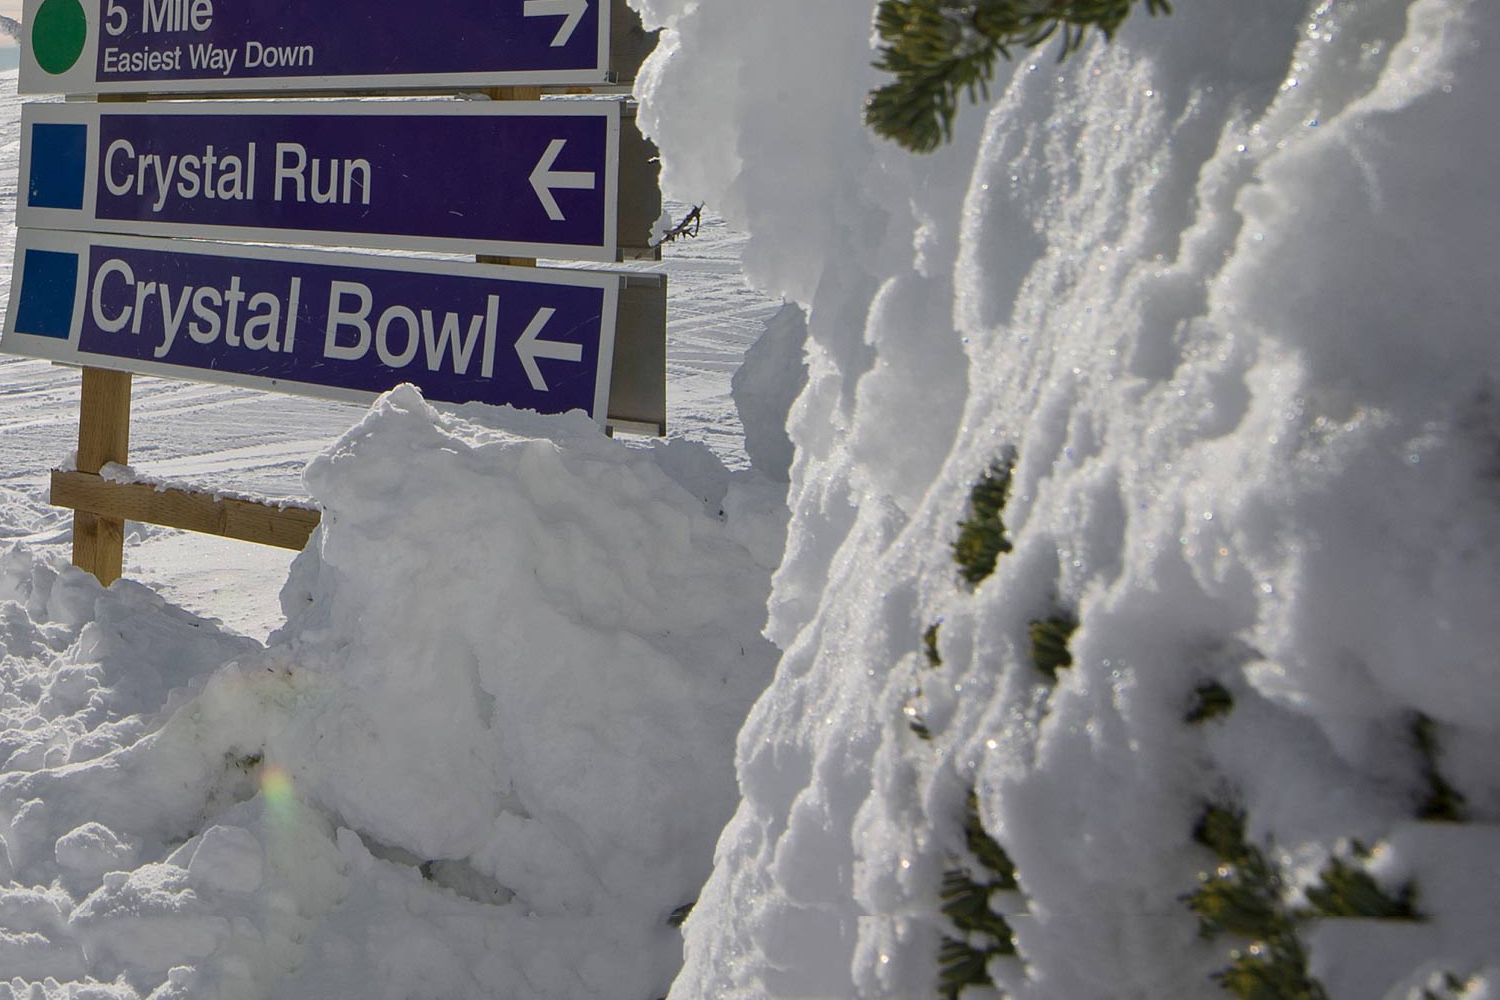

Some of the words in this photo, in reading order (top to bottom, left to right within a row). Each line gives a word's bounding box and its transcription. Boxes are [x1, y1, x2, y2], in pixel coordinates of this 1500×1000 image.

[103, 47, 182, 73] Easiest
[188, 44, 237, 76] Way
[244, 41, 314, 68] Down
[104, 139, 256, 212] Crystal
[274, 142, 371, 205] Run
[91, 258, 302, 358] Crystal
[323, 280, 500, 378] Bowl
